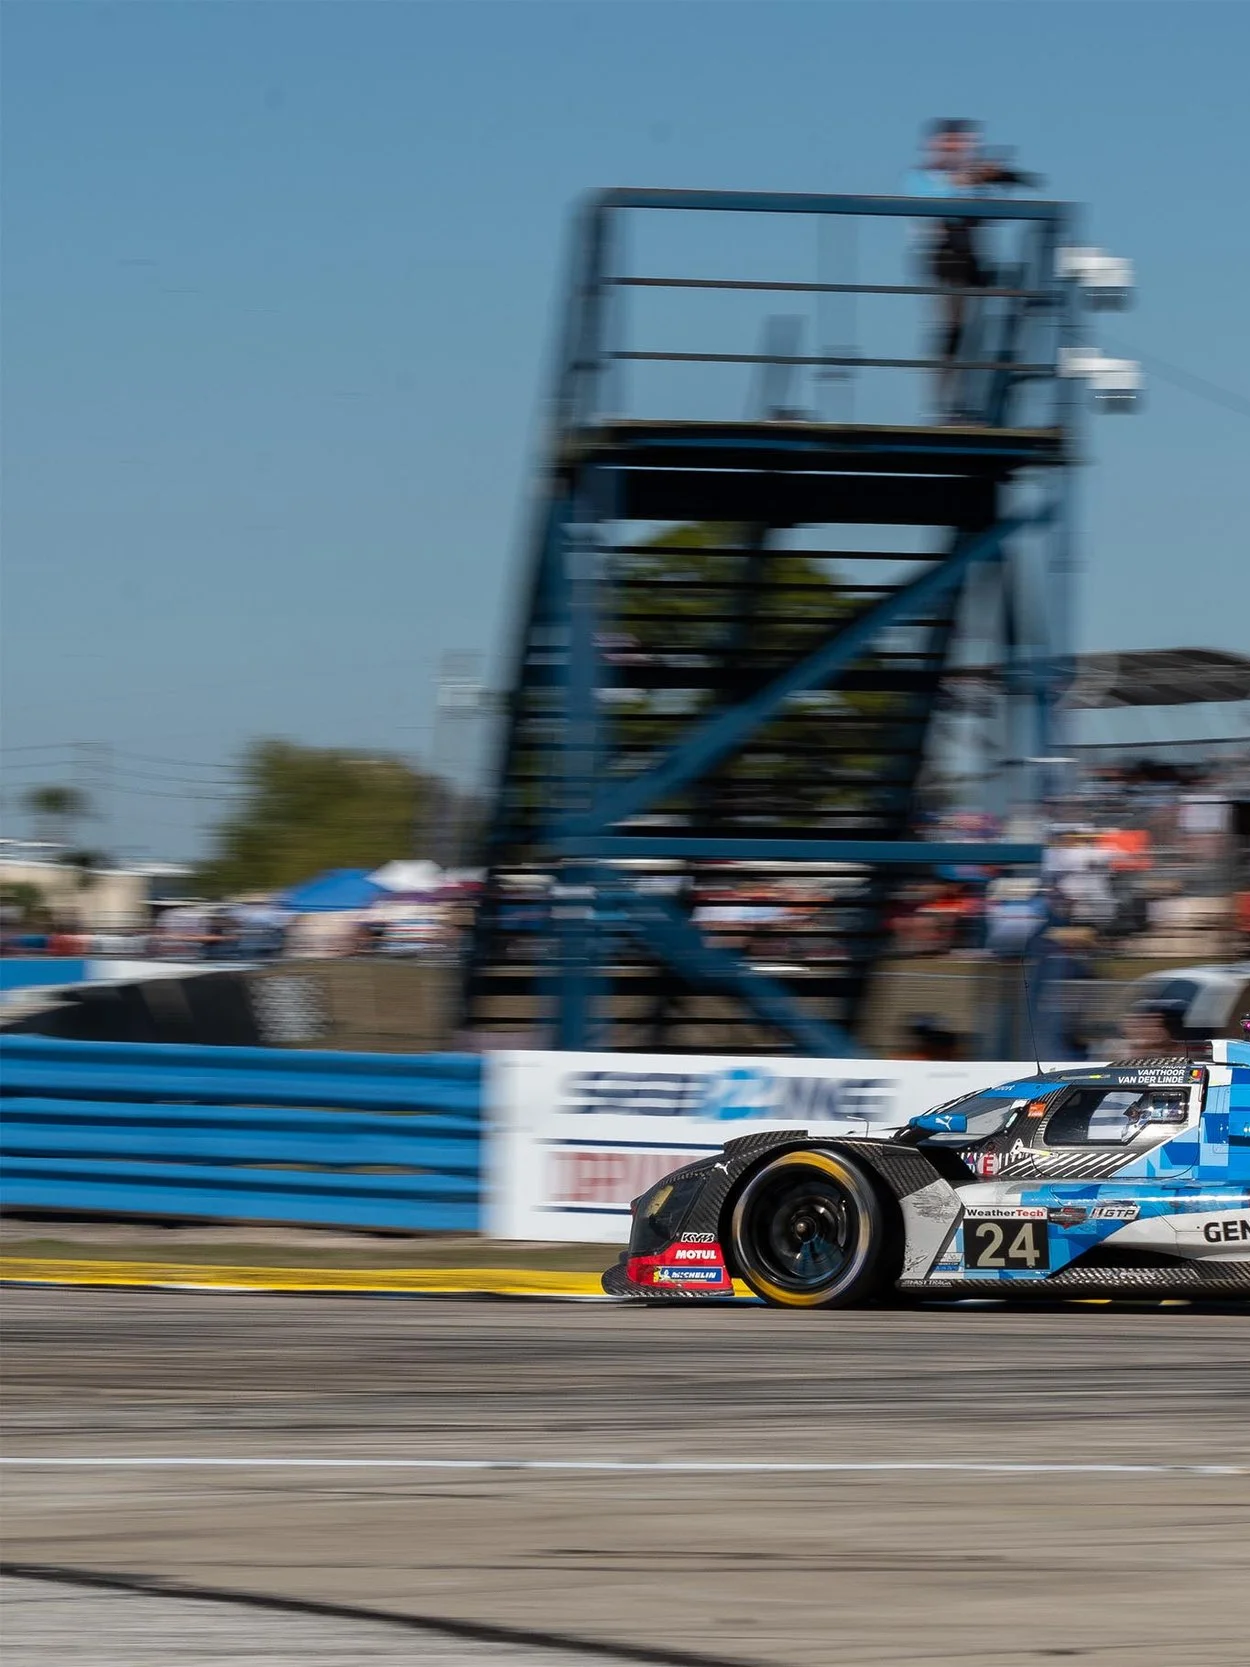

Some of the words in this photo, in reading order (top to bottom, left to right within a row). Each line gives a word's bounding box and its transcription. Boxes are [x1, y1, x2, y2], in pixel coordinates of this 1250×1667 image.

[1118, 1076, 1137, 1084] VAN
[1138, 1076, 1155, 1084] DER
[1157, 1076, 1184, 1084] LINDE
[967, 1207, 1045, 1217] WeatherTech
[1104, 1208, 1136, 1217] GTP
[681, 1232, 715, 1243] KYB
[975, 1222, 1041, 1267] 24
[675, 1250, 717, 1260] MOTUL
[671, 1271, 717, 1279] MICHELIN
